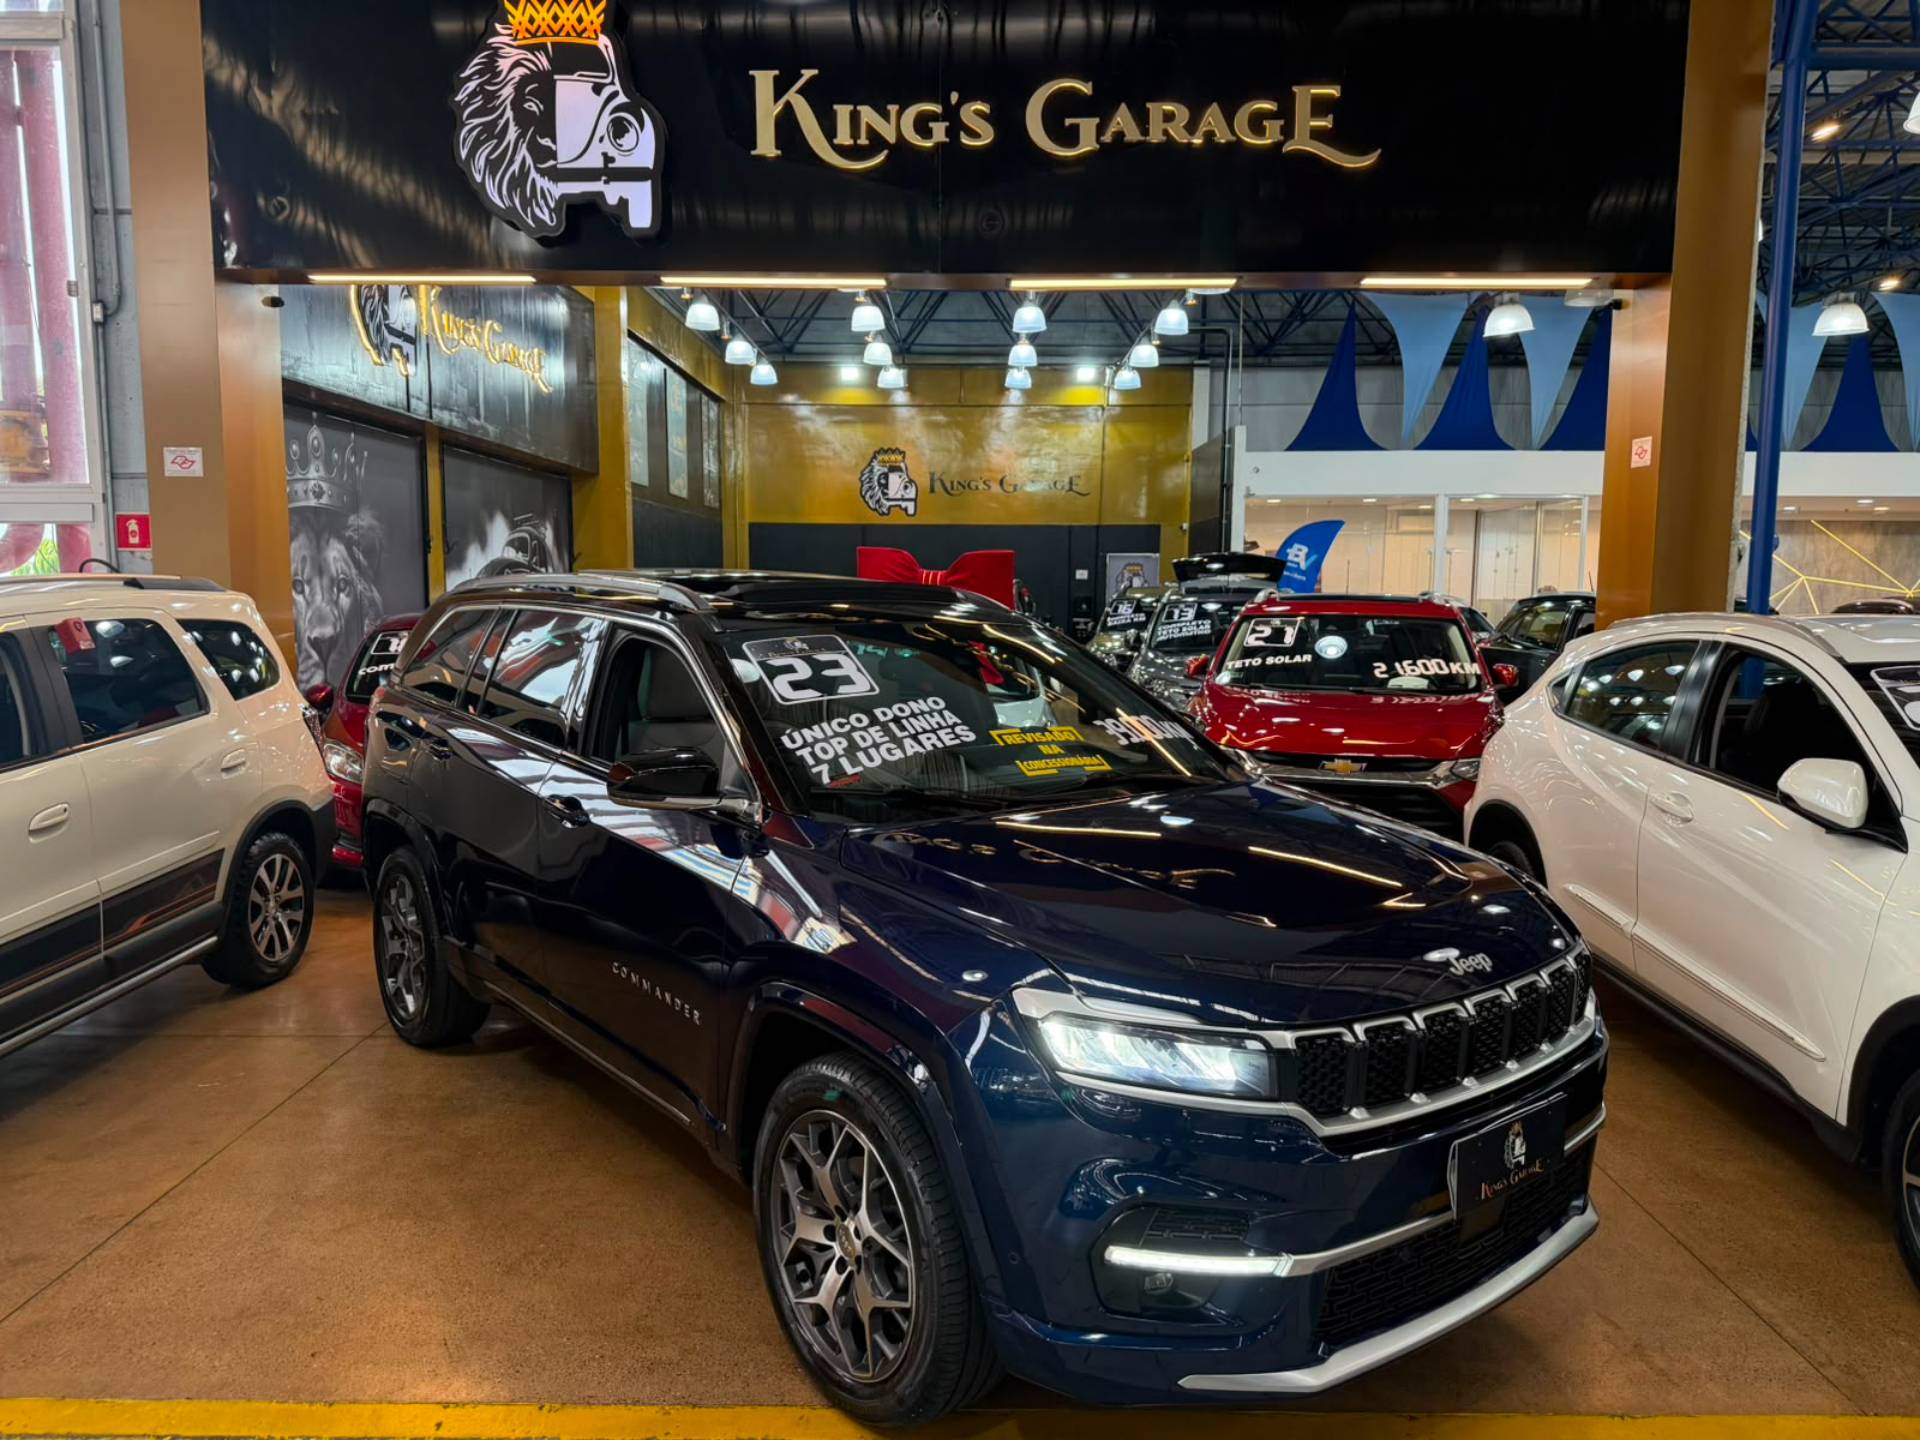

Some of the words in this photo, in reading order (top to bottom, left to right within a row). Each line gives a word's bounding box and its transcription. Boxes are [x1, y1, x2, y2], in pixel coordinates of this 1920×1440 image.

[749, 68, 995, 170] KING'S
[1025, 78, 1382, 169] GARAGE
[928, 471, 993, 497] KING'S
[999, 474, 1091, 497] GAGE
[1169, 606, 1195, 621] 13
[1247, 625, 1295, 645] 21
[1226, 657, 1263, 670] TETO
[1265, 654, 1313, 666] SOLAR
[765, 653, 872, 700] 23
[780, 712, 870, 751] ÚNICO
[873, 696, 946, 723] DONO
[795, 736, 849, 767] TOP
[852, 725, 890, 749] DE
[888, 709, 963, 739] LINHA
[1002, 730, 1077, 745] REVISADO
[1038, 744, 1065, 756] NA
[811, 763, 832, 785] 7
[838, 725, 977, 776] LUGARES
[1449, 952, 1493, 976] Jeep
[611, 961, 701, 1026] COMMANDER
